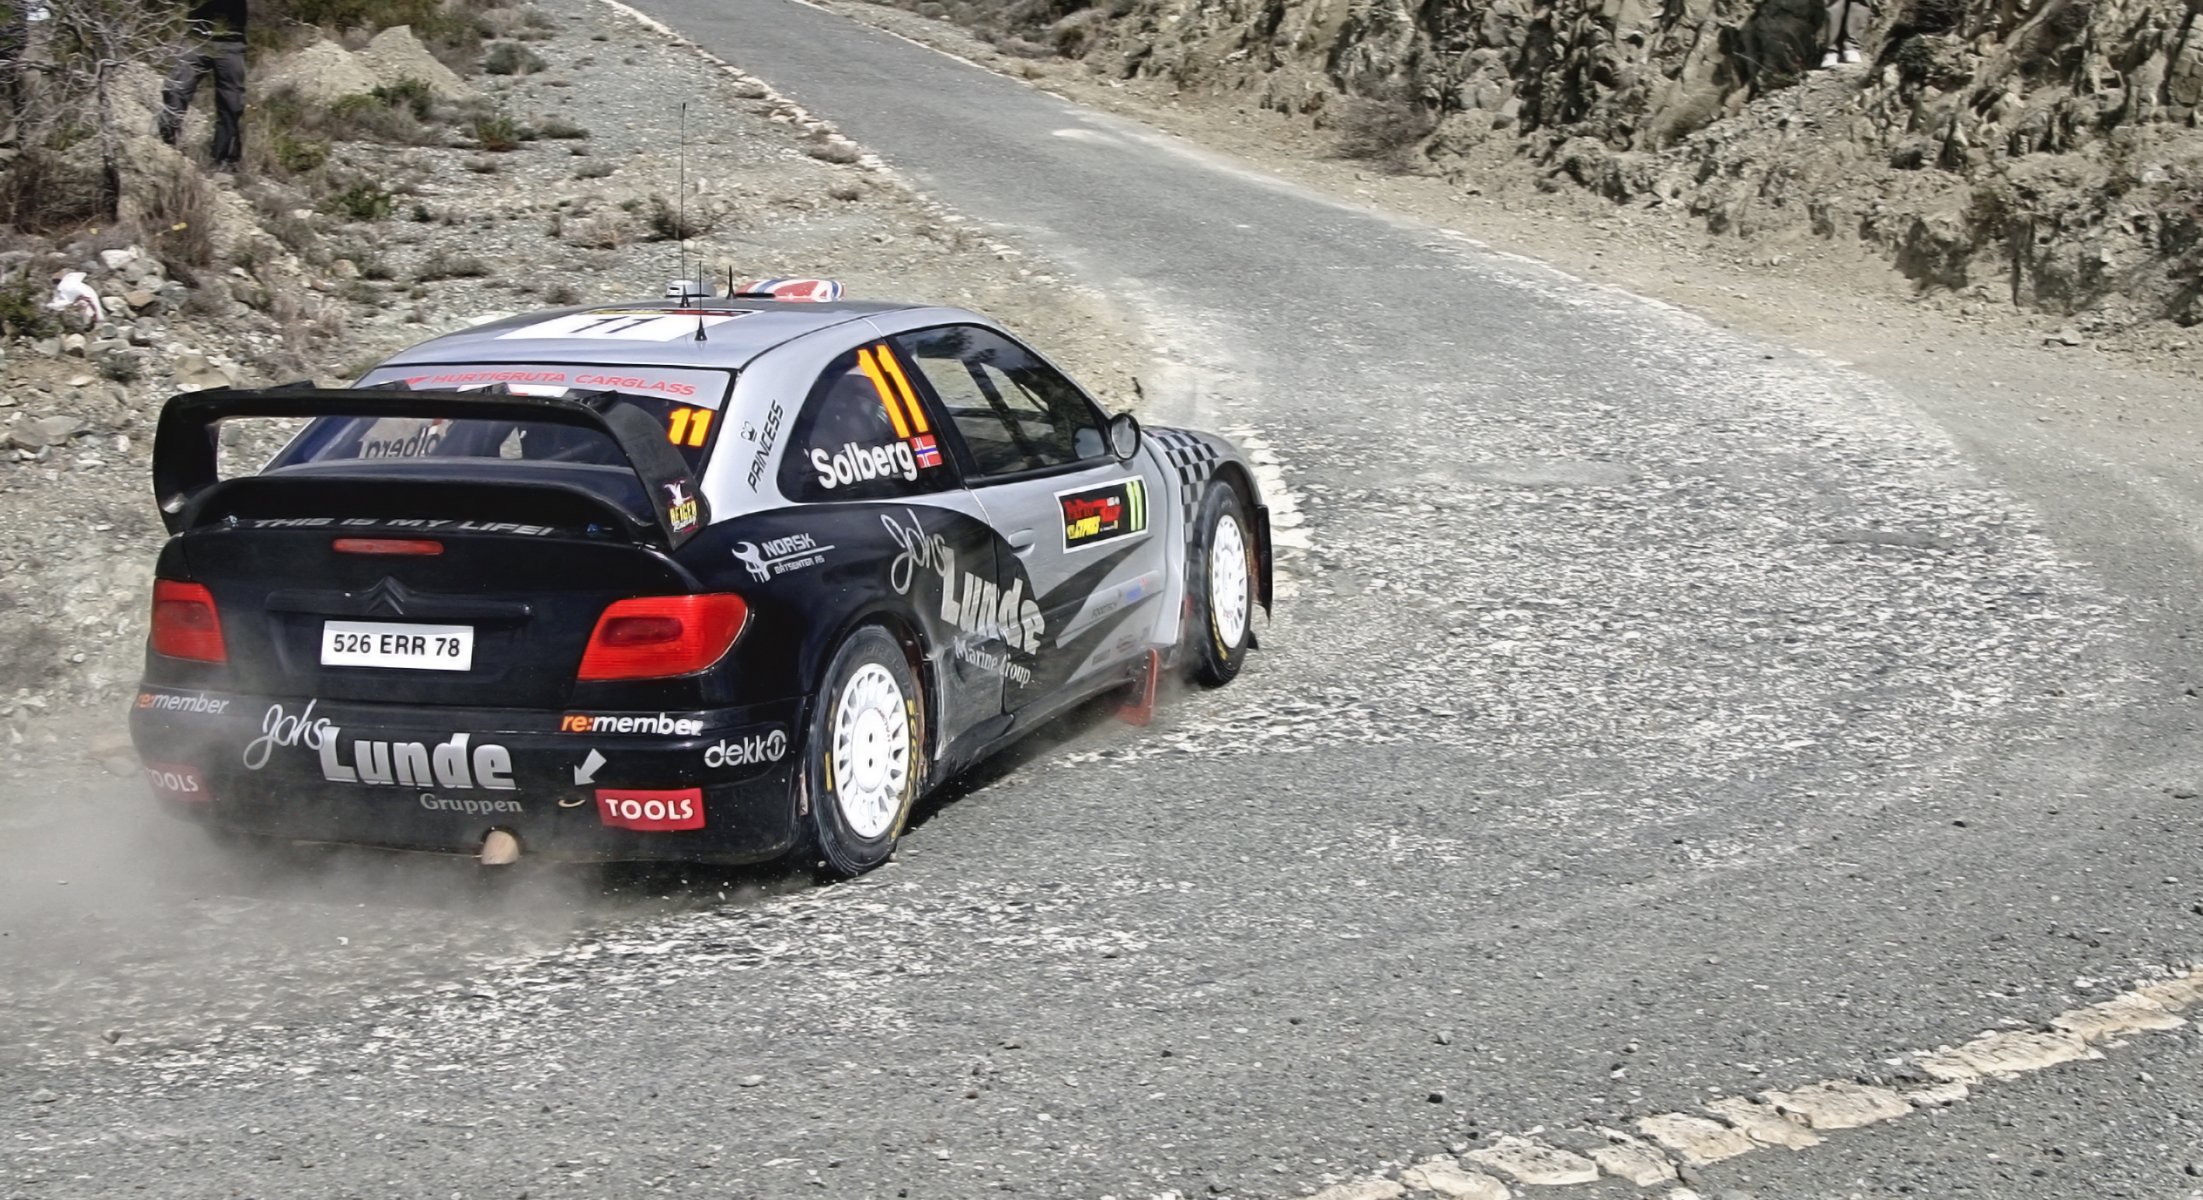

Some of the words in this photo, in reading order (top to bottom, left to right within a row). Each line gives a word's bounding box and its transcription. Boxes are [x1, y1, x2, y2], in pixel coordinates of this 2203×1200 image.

[431, 371, 566, 384] HURTIGRUTA
[575, 374, 697, 397] CARGLASS
[857, 344, 930, 439] 11
[668, 407, 715, 448] 11
[747, 399, 785, 493] PRINCESS
[810, 442, 919, 490] Solberg
[254, 518, 335, 528] THIS
[340, 518, 380, 526] IS
[386, 519, 454, 527] MY
[1125, 480, 1144, 532] 11
[761, 532, 817, 558] NORSK
[941, 546, 1046, 656] Lunde
[333, 633, 372, 654] 526
[380, 635, 427, 657] ERR
[435, 637, 461, 658] 78
[953, 635, 999, 671] Marine
[560, 711, 704, 736] re:member
[318, 726, 517, 790] Lunde
[419, 792, 523, 815] Gruppen
[605, 798, 695, 821] TOOLS
